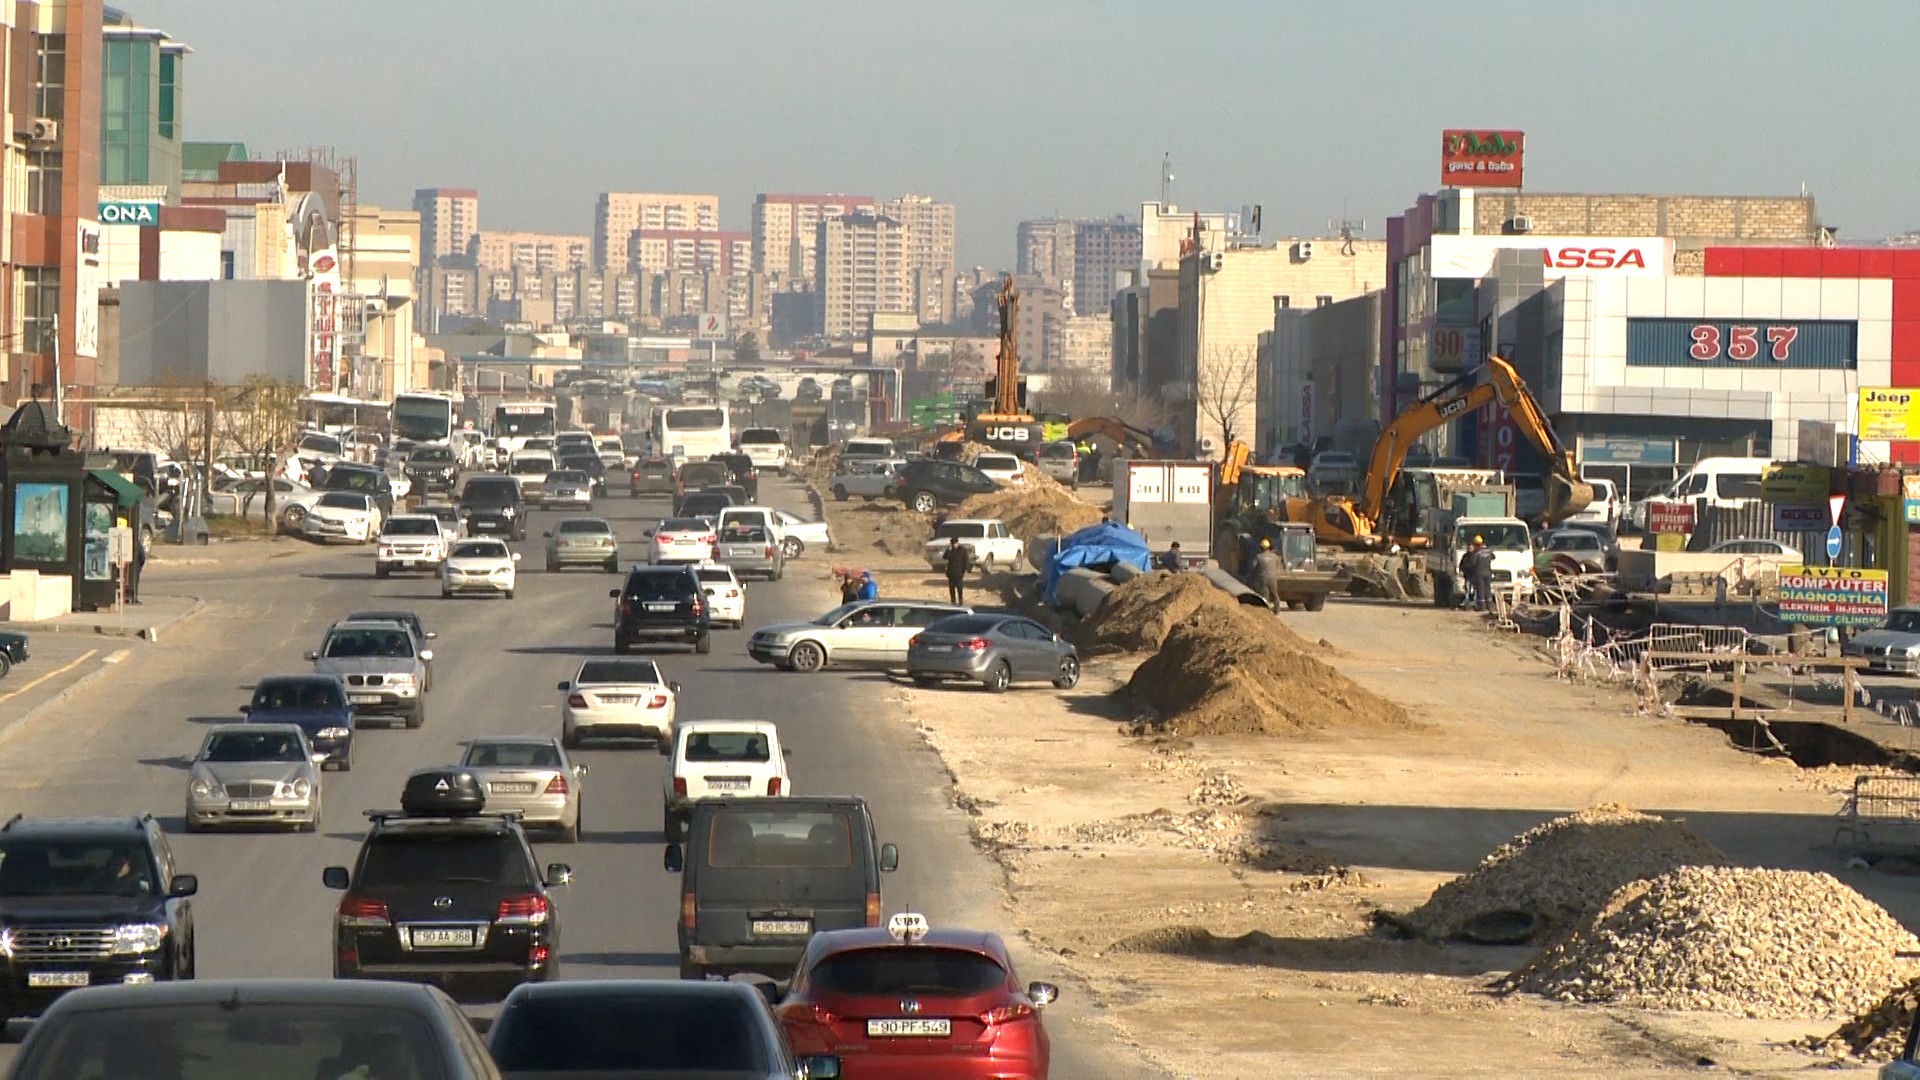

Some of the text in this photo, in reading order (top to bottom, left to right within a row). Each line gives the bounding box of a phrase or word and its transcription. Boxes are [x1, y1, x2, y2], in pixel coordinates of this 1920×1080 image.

[98, 205, 152, 221] ONA
[1865, 391, 1910, 406] Jeep
[1440, 399, 1467, 418] JCB
[986, 427, 1029, 441] JCB
[1802, 569, 1862, 578] AVTO
[1780, 577, 1885, 592] KOMPYUTER
